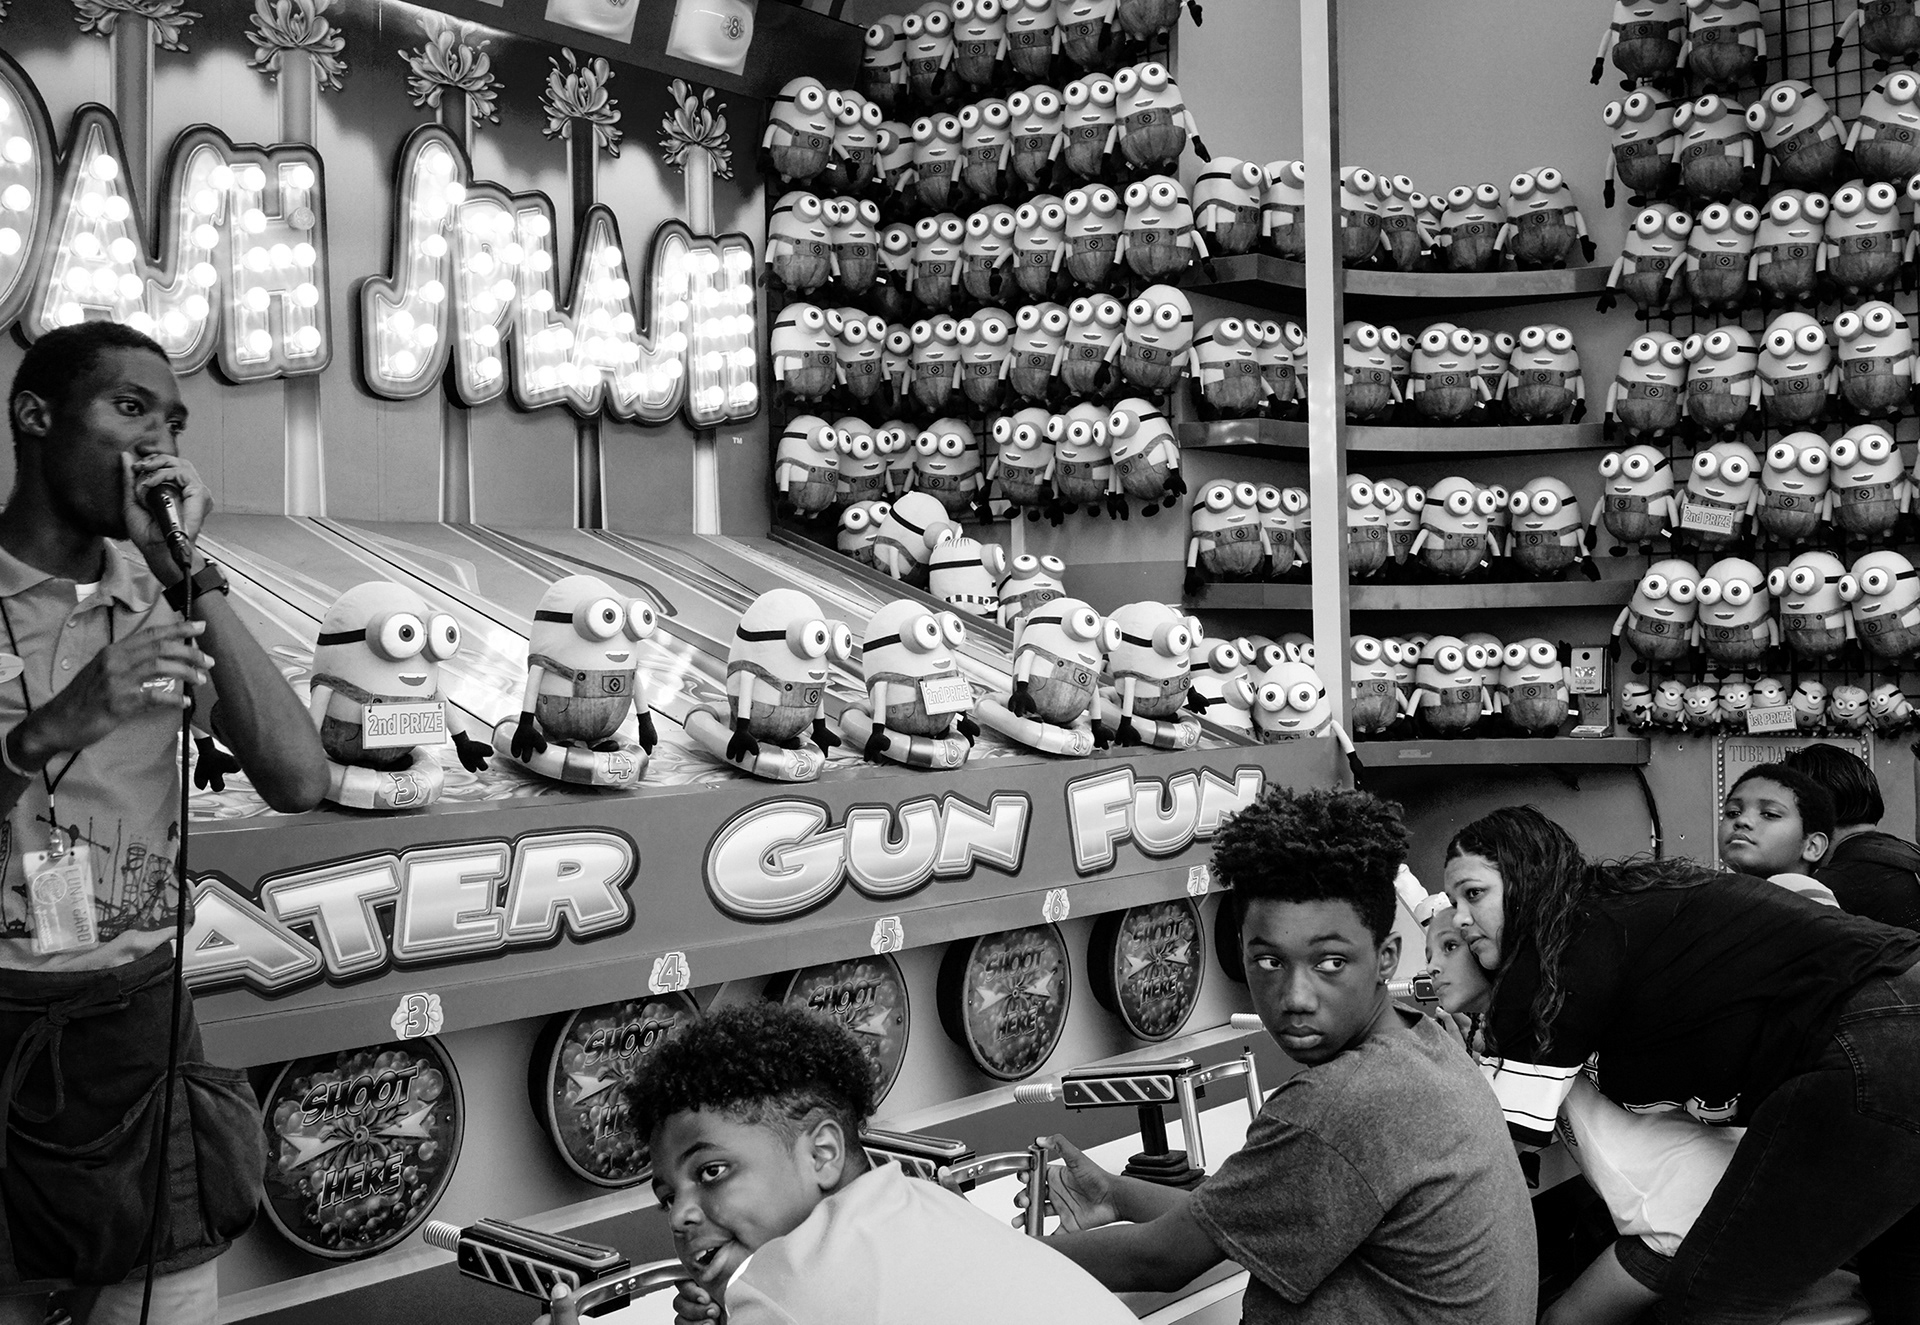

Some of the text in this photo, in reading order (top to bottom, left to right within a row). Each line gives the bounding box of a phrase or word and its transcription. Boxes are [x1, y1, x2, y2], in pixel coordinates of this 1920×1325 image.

[728, 15, 741, 40] 8
[366, 128, 758, 420] SPLASH
[1684, 509, 1732, 528] 2nd PRIZE
[926, 683, 970, 706] 2nd PRIZE
[368, 711, 443, 736] 2nd PRIZE
[1750, 710, 1793, 727] 1st PRIZE
[608, 752, 632, 779] 4
[1729, 745, 1764, 762] TUBE
[388, 772, 419, 805] 3
[180, 767, 1266, 988] ATER GUN FUN
[1188, 866, 1205, 896] 7
[1050, 890, 1063, 922] 6
[879, 918, 897, 953] 5
[1132, 916, 1184, 950] SHOOT
[658, 953, 682, 992] 4
[985, 944, 1046, 983] SHOOT
[1140, 972, 1178, 1006] HERE
[404, 995, 429, 1038] 3
[994, 1003, 1038, 1042] HERE
[301, 1066, 419, 1127] SHOOT
[320, 1152, 404, 1208] HERE
